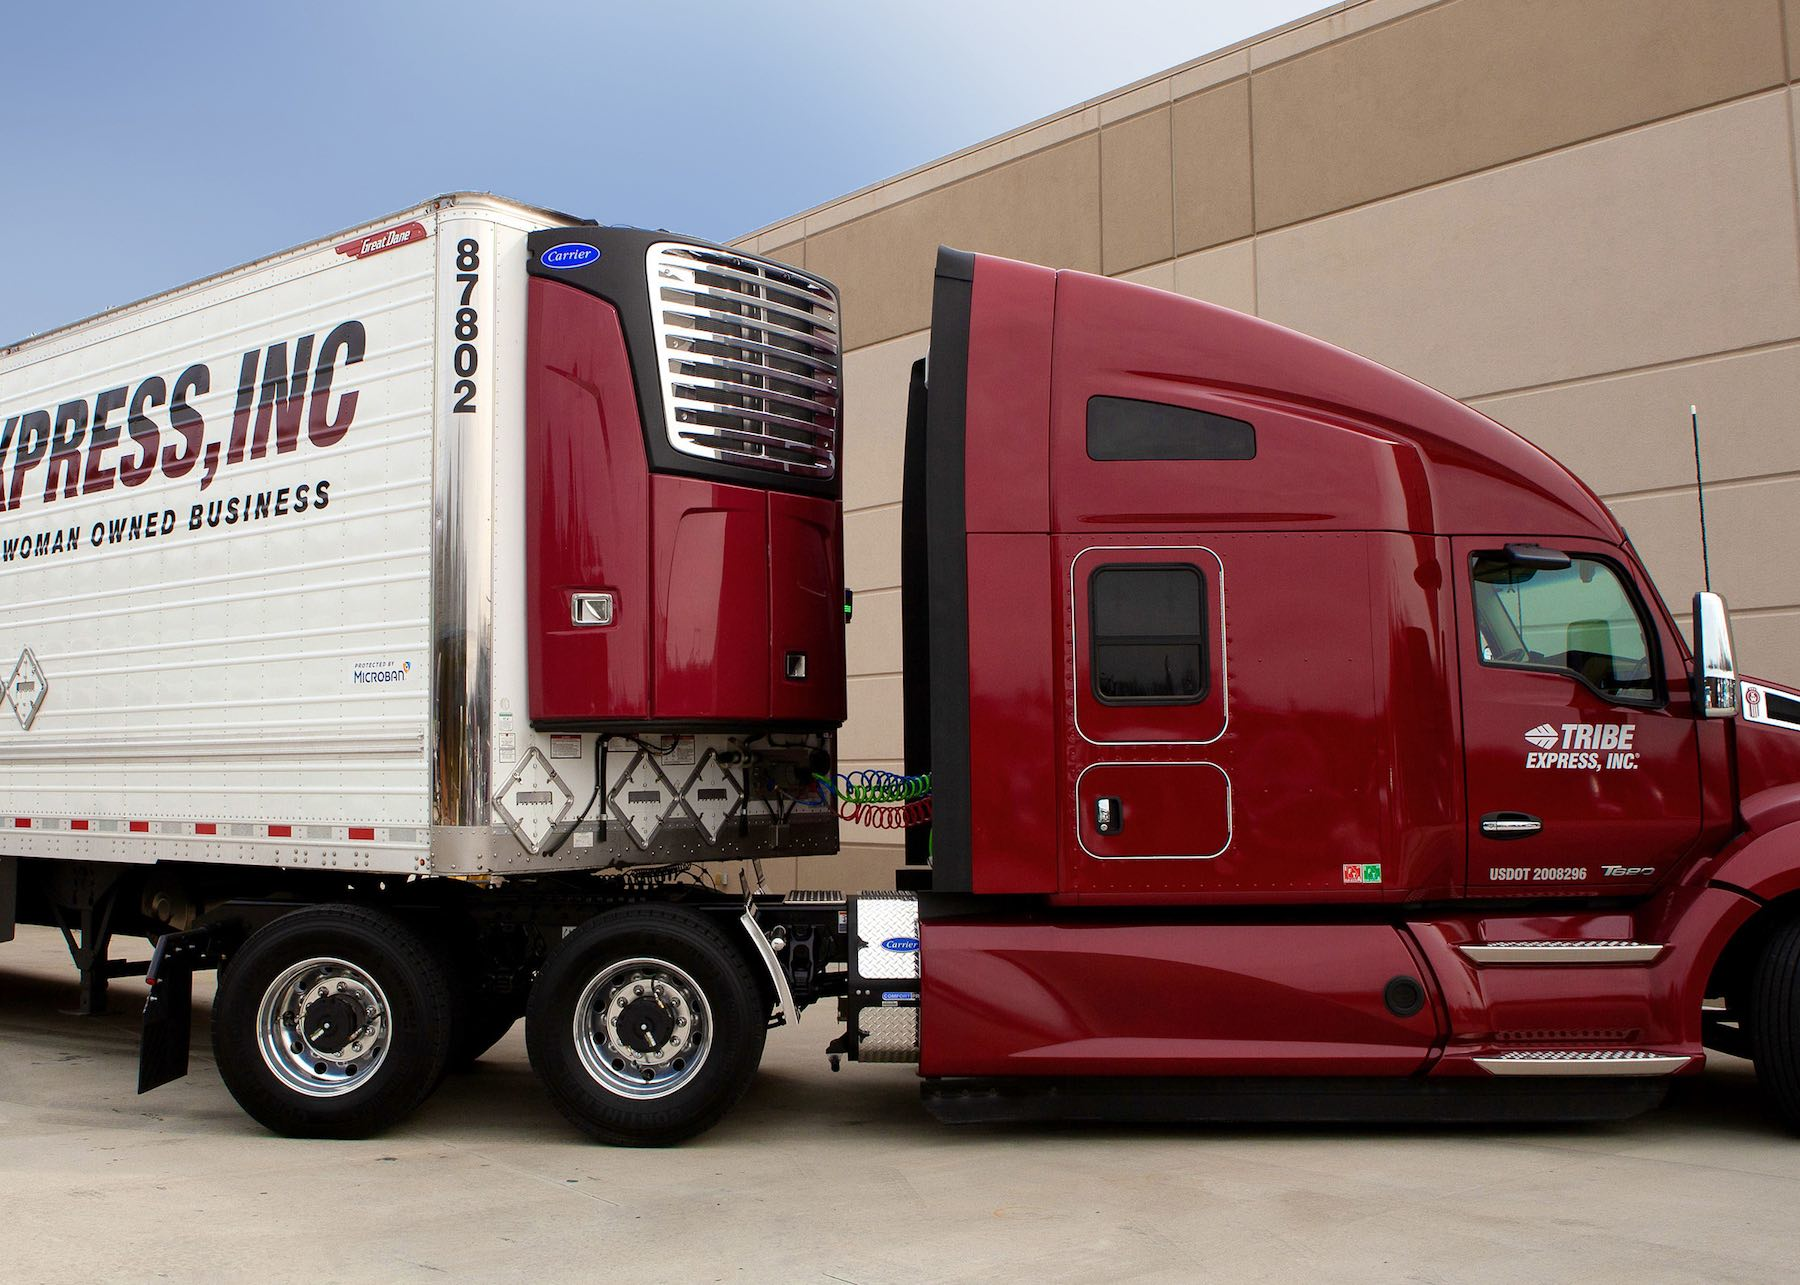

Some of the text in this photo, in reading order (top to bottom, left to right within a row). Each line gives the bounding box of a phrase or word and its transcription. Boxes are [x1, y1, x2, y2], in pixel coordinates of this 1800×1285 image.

[361, 230, 411, 254] Great Dane
[547, 249, 592, 262] Carrier
[453, 238, 480, 413] 87802
[2, 480, 331, 562] WOMAN OWNED BUSINESS
[1561, 724, 1636, 750] TRIBE
[1525, 752, 1602, 772] EXPRESS,
[1489, 867, 1588, 881] USDOT 2008296
[1601, 865, 1656, 877] T680
[886, 940, 919, 949] Carrier
